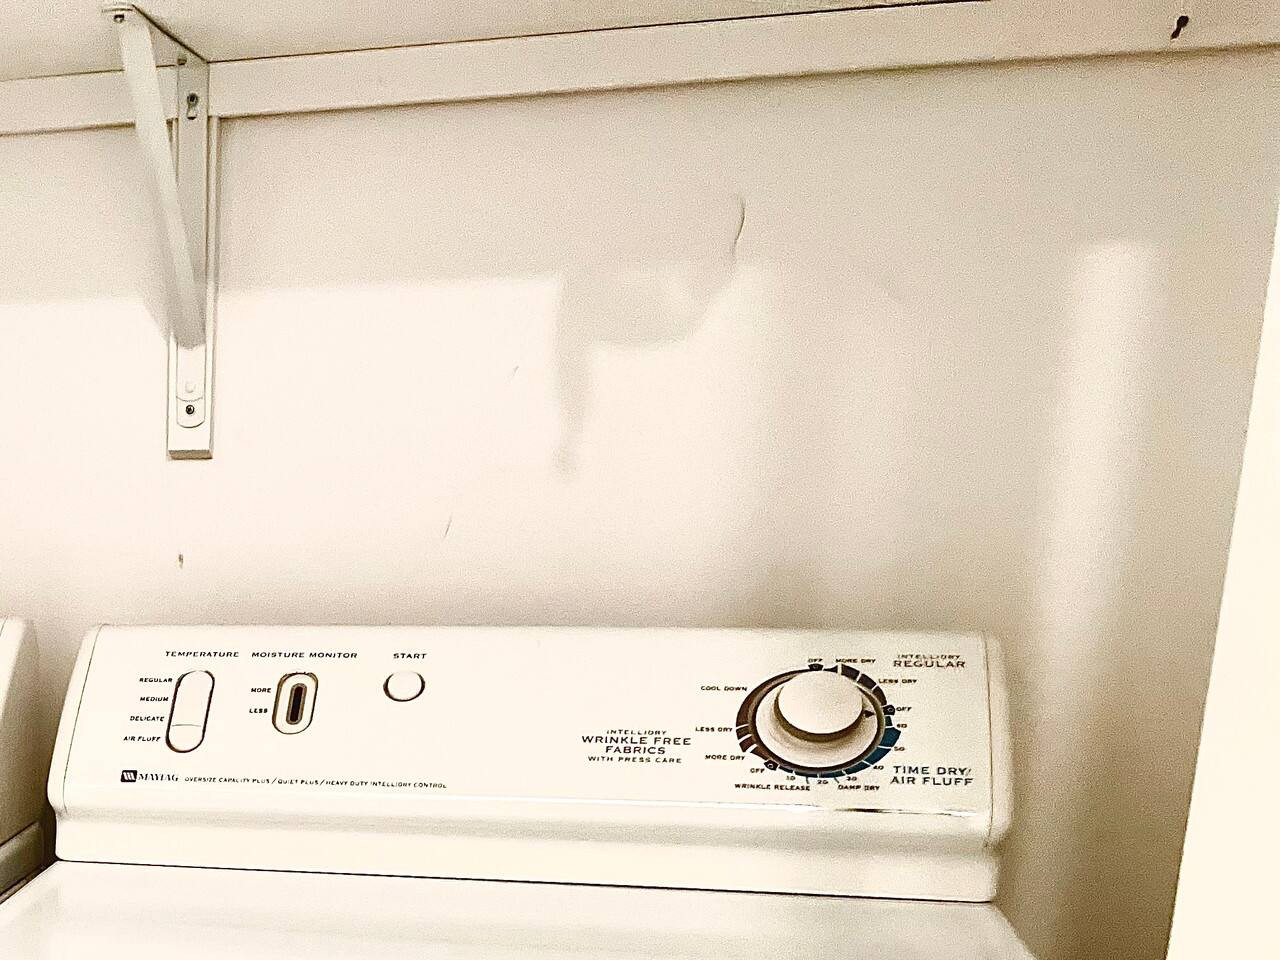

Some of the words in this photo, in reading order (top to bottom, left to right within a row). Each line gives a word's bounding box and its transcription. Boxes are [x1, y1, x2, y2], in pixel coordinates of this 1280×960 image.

[165, 650, 240, 658] TEMPERATURE
[251, 651, 305, 659] MOISTURE
[393, 652, 427, 660] START
[893, 660, 966, 668] REGULAR
[581, 735, 648, 745] WRINKLE
[653, 737, 692, 746] FREE
[605, 745, 666, 755] FABRICS
[893, 765, 930, 775] TIME
[890, 776, 916, 785] AIR
[921, 776, 974, 786] FLUFF
